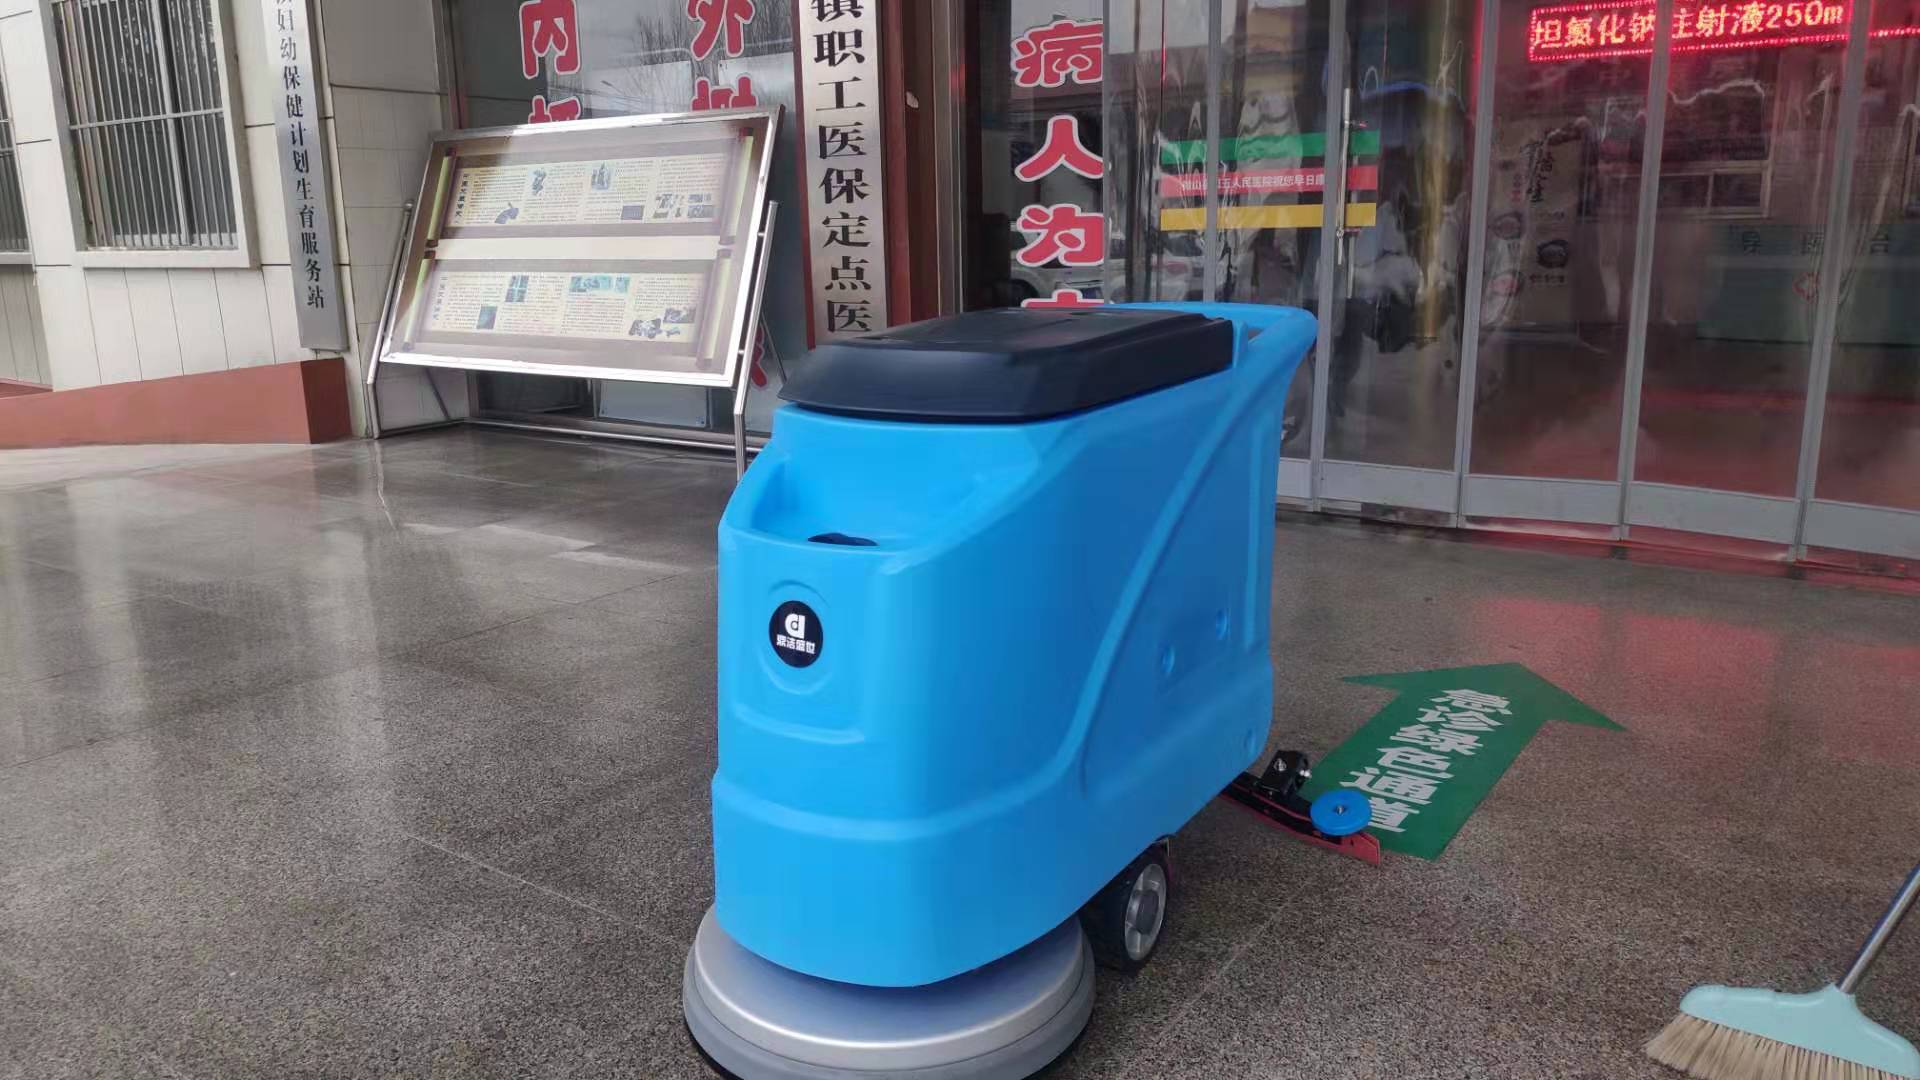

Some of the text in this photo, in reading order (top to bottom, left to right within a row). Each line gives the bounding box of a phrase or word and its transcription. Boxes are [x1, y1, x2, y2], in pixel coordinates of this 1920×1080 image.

[276, 0, 324, 309] 妇幼保健计划生育服务站
[1010, 20, 1104, 308] 病人为
